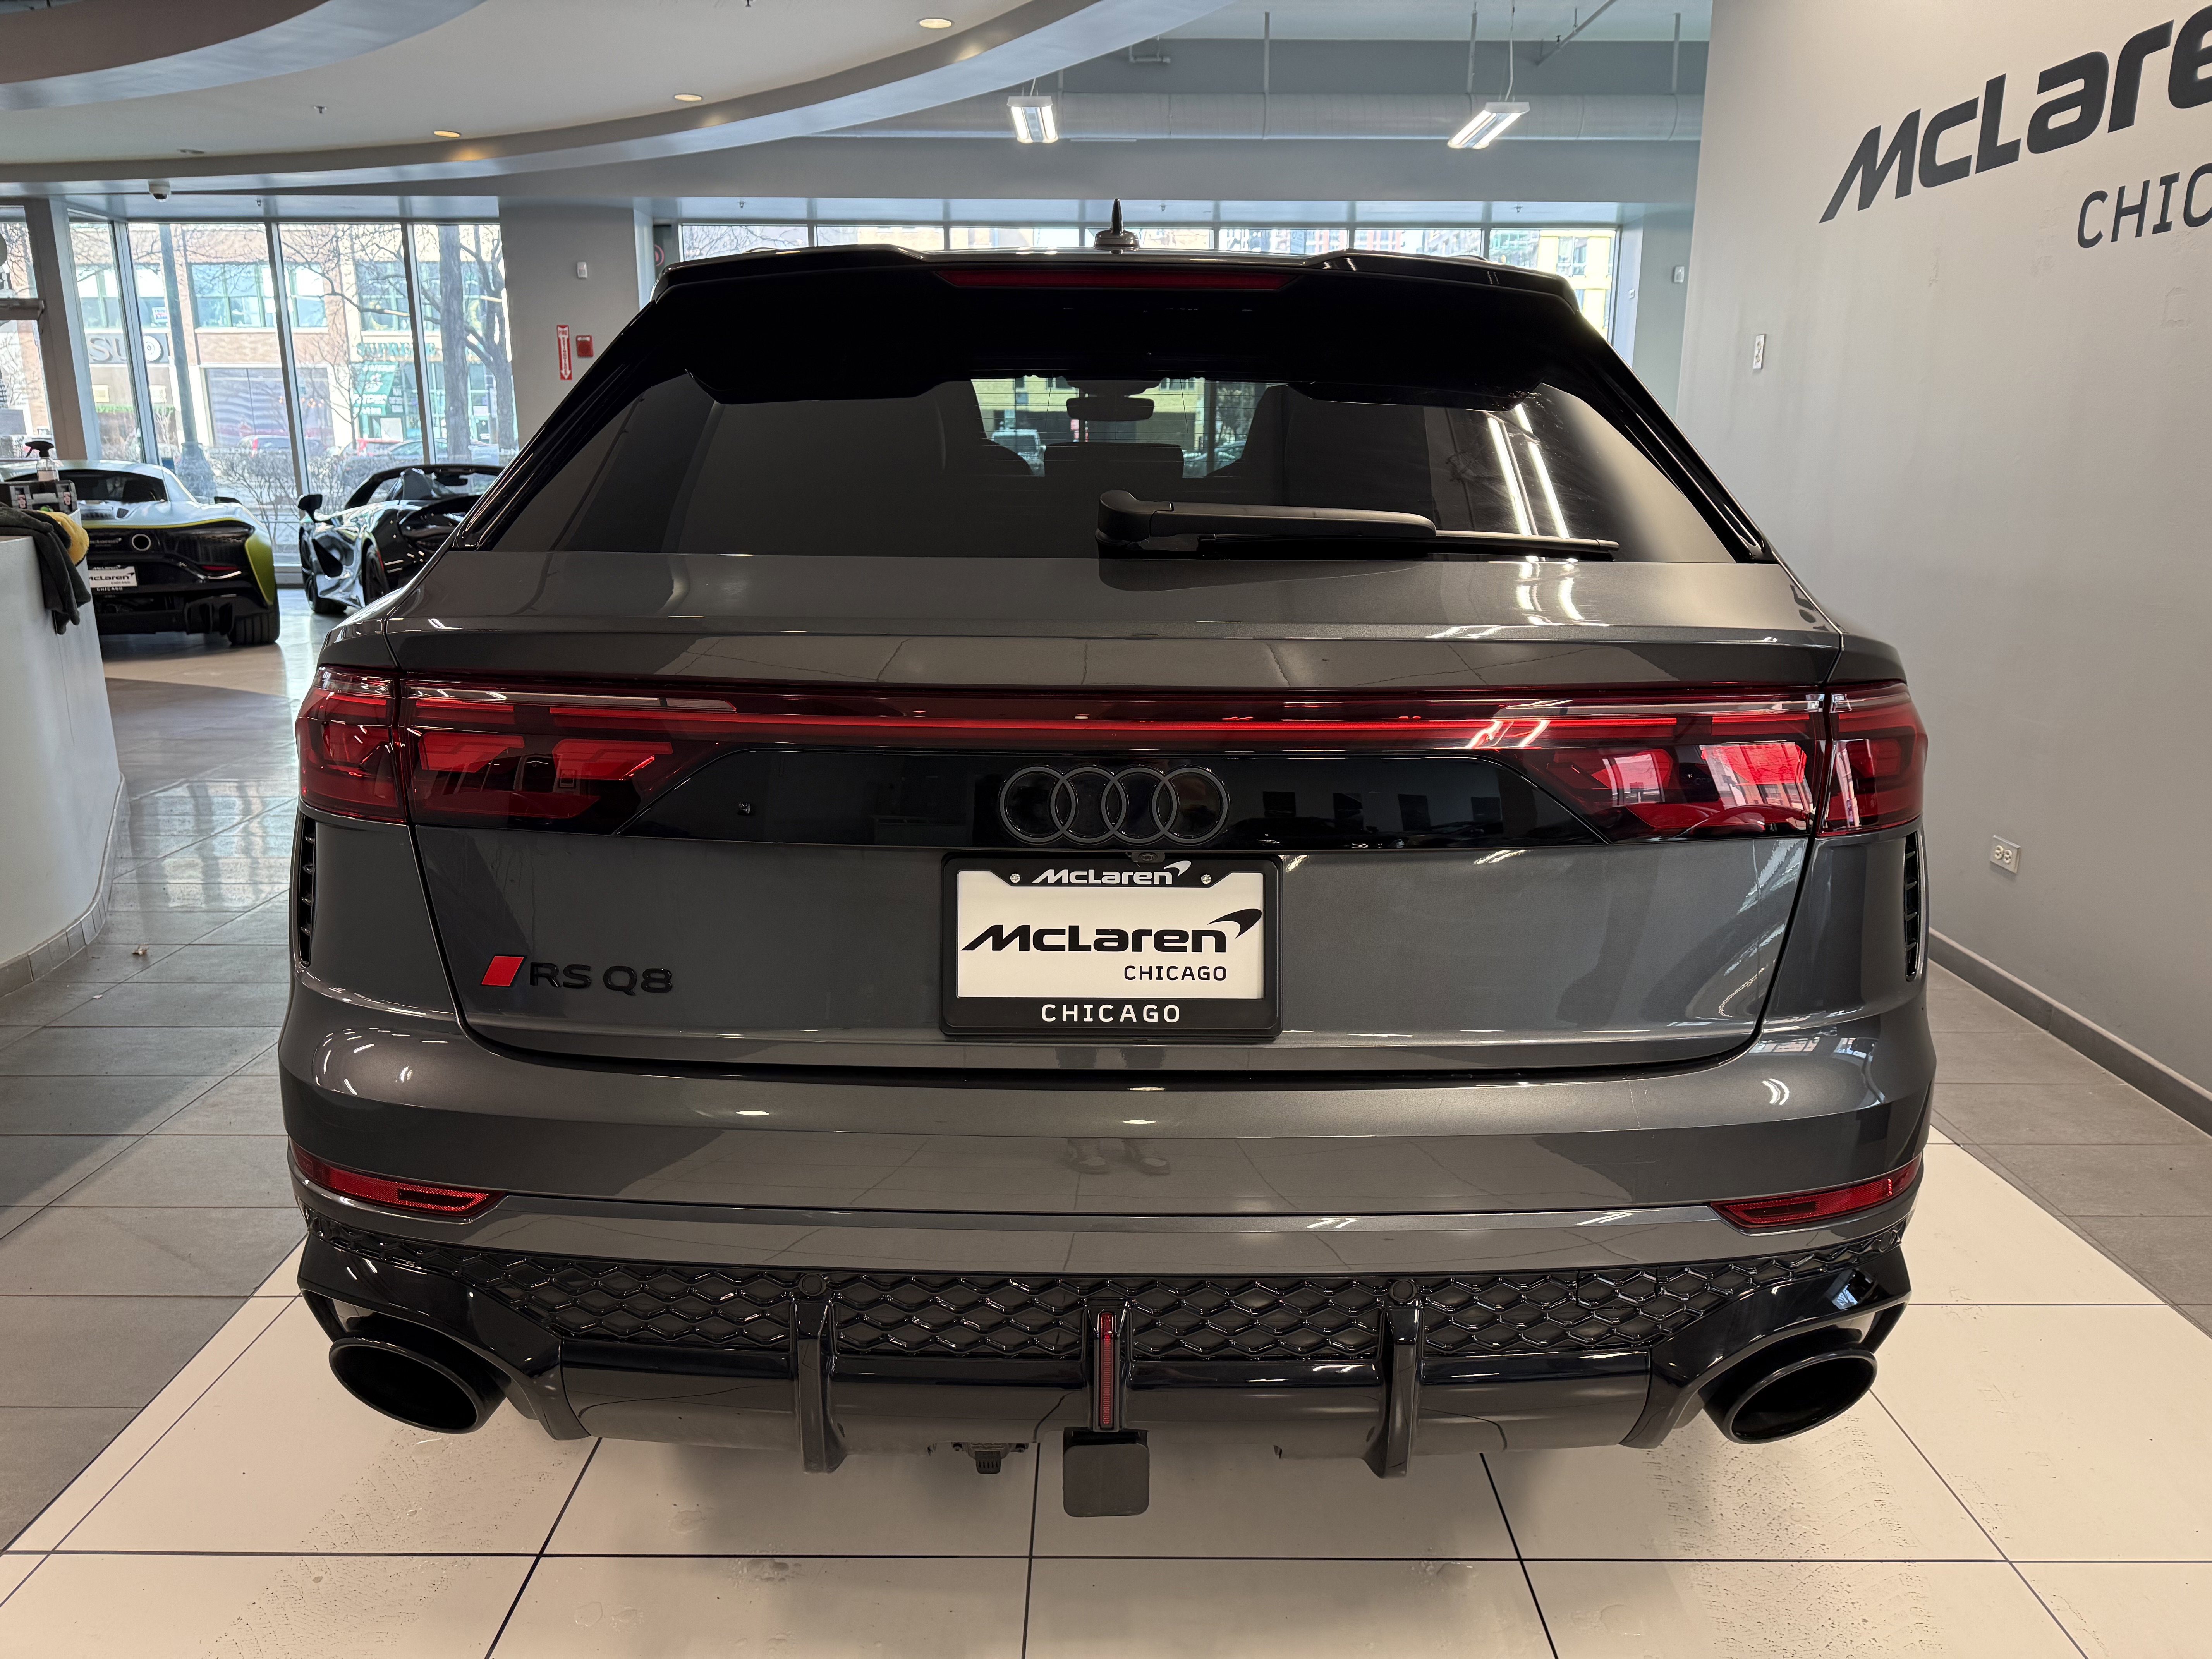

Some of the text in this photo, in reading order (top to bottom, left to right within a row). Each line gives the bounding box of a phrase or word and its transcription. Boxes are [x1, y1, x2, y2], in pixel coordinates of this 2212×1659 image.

[1032, 869, 1173, 884] McLaren
[961, 925, 1226, 953] McLaren
[530, 962, 673, 996] RS Q8
[1124, 965, 1227, 981] CHICAGO
[1041, 1004, 1180, 1024] CHICAGO
